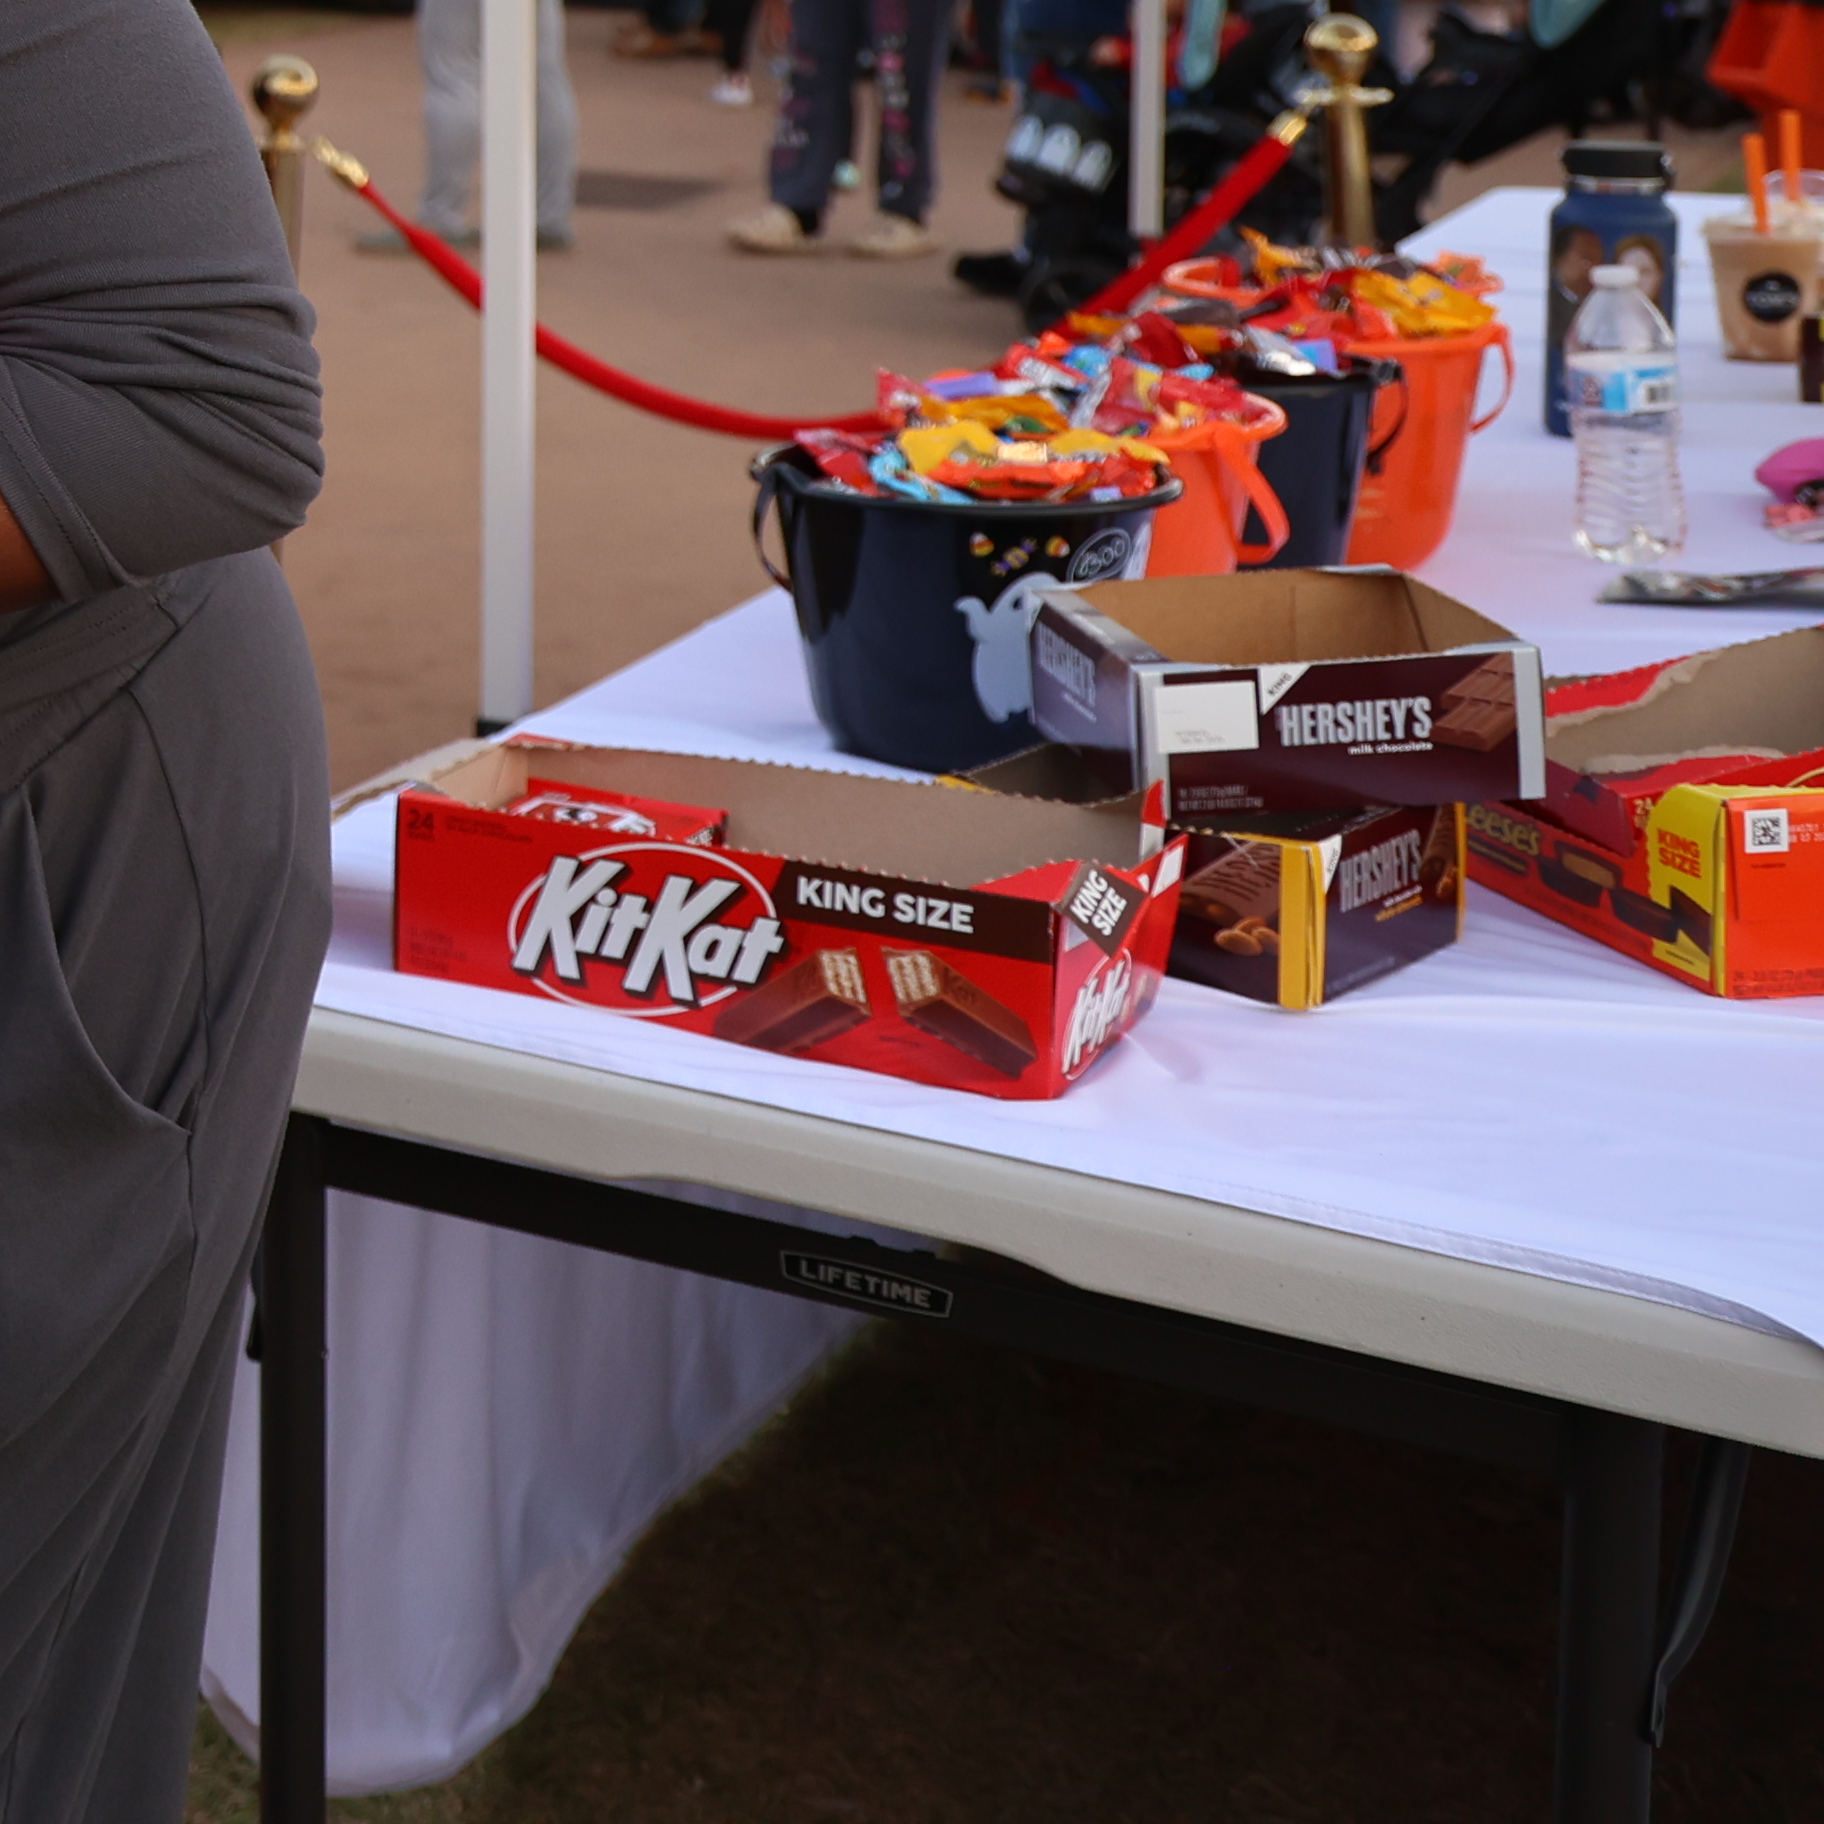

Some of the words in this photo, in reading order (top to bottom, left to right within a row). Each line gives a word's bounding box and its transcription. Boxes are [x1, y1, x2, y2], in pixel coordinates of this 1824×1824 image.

[1266, 672, 1293, 697] KING
[1279, 695, 1433, 747] HERSHEY'S
[1348, 745, 1374, 756] milk
[1376, 741, 1433, 754] chocolate
[1657, 828, 1701, 859] KING
[1659, 847, 1702, 879] SIZE
[1069, 868, 1109, 924] KING
[1338, 827, 1424, 914] HERSHEY'S
[511, 855, 786, 1004] KitKat
[797, 875, 886, 919] KING
[894, 891, 974, 934] SIZE
[1090, 886, 1128, 938] SIZE
[1060, 959, 1132, 1075] KitKat
[801, 1257, 932, 1308] LIFETIME
